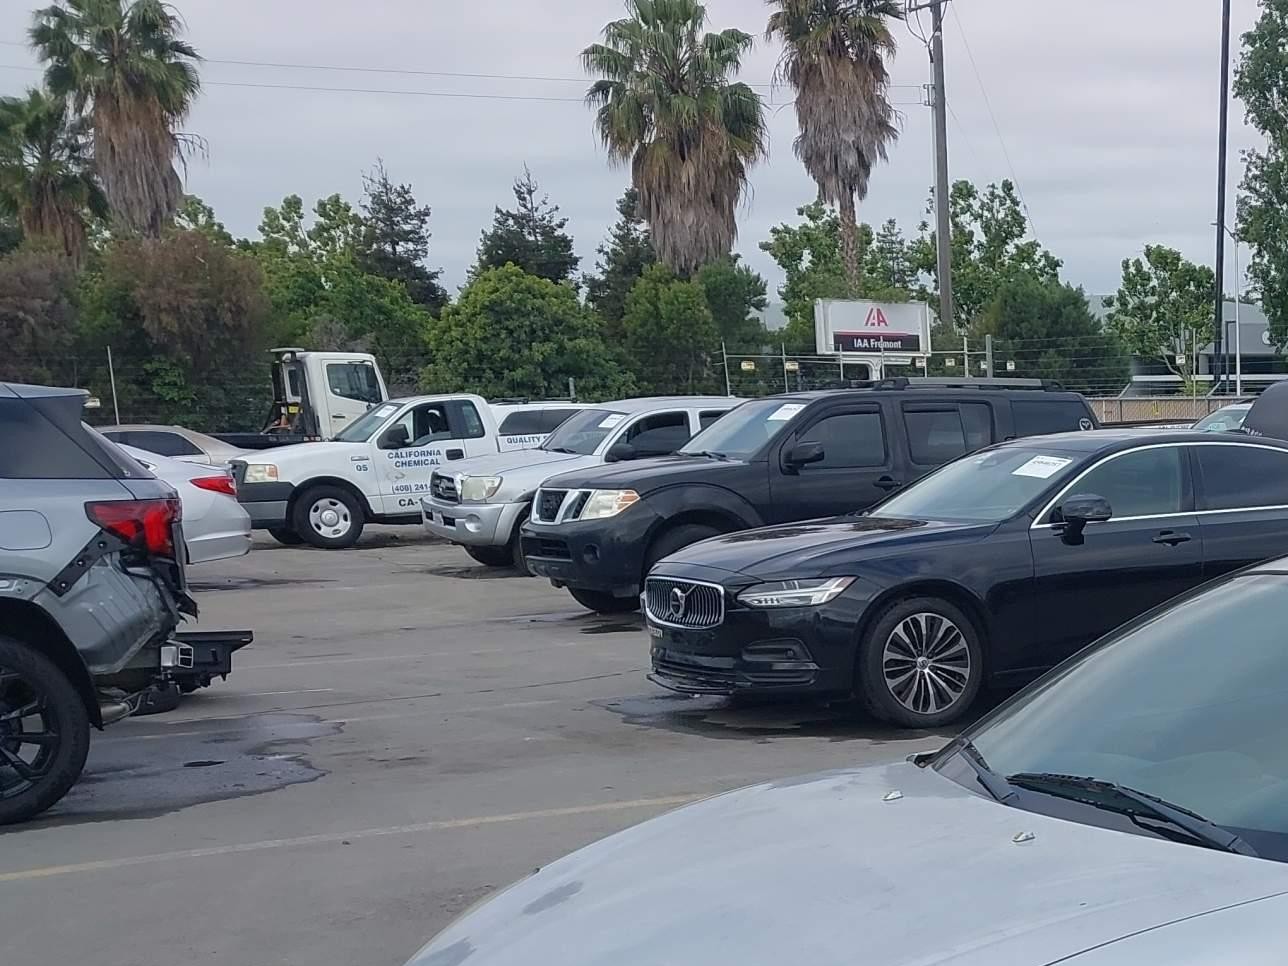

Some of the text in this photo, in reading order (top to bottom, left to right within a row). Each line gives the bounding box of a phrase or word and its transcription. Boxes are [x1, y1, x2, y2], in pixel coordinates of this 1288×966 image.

[853, 337, 869, 348] IAA
[387, 450, 441, 459] CALIFORNIA
[395, 459, 441, 467] CHEMICAL
